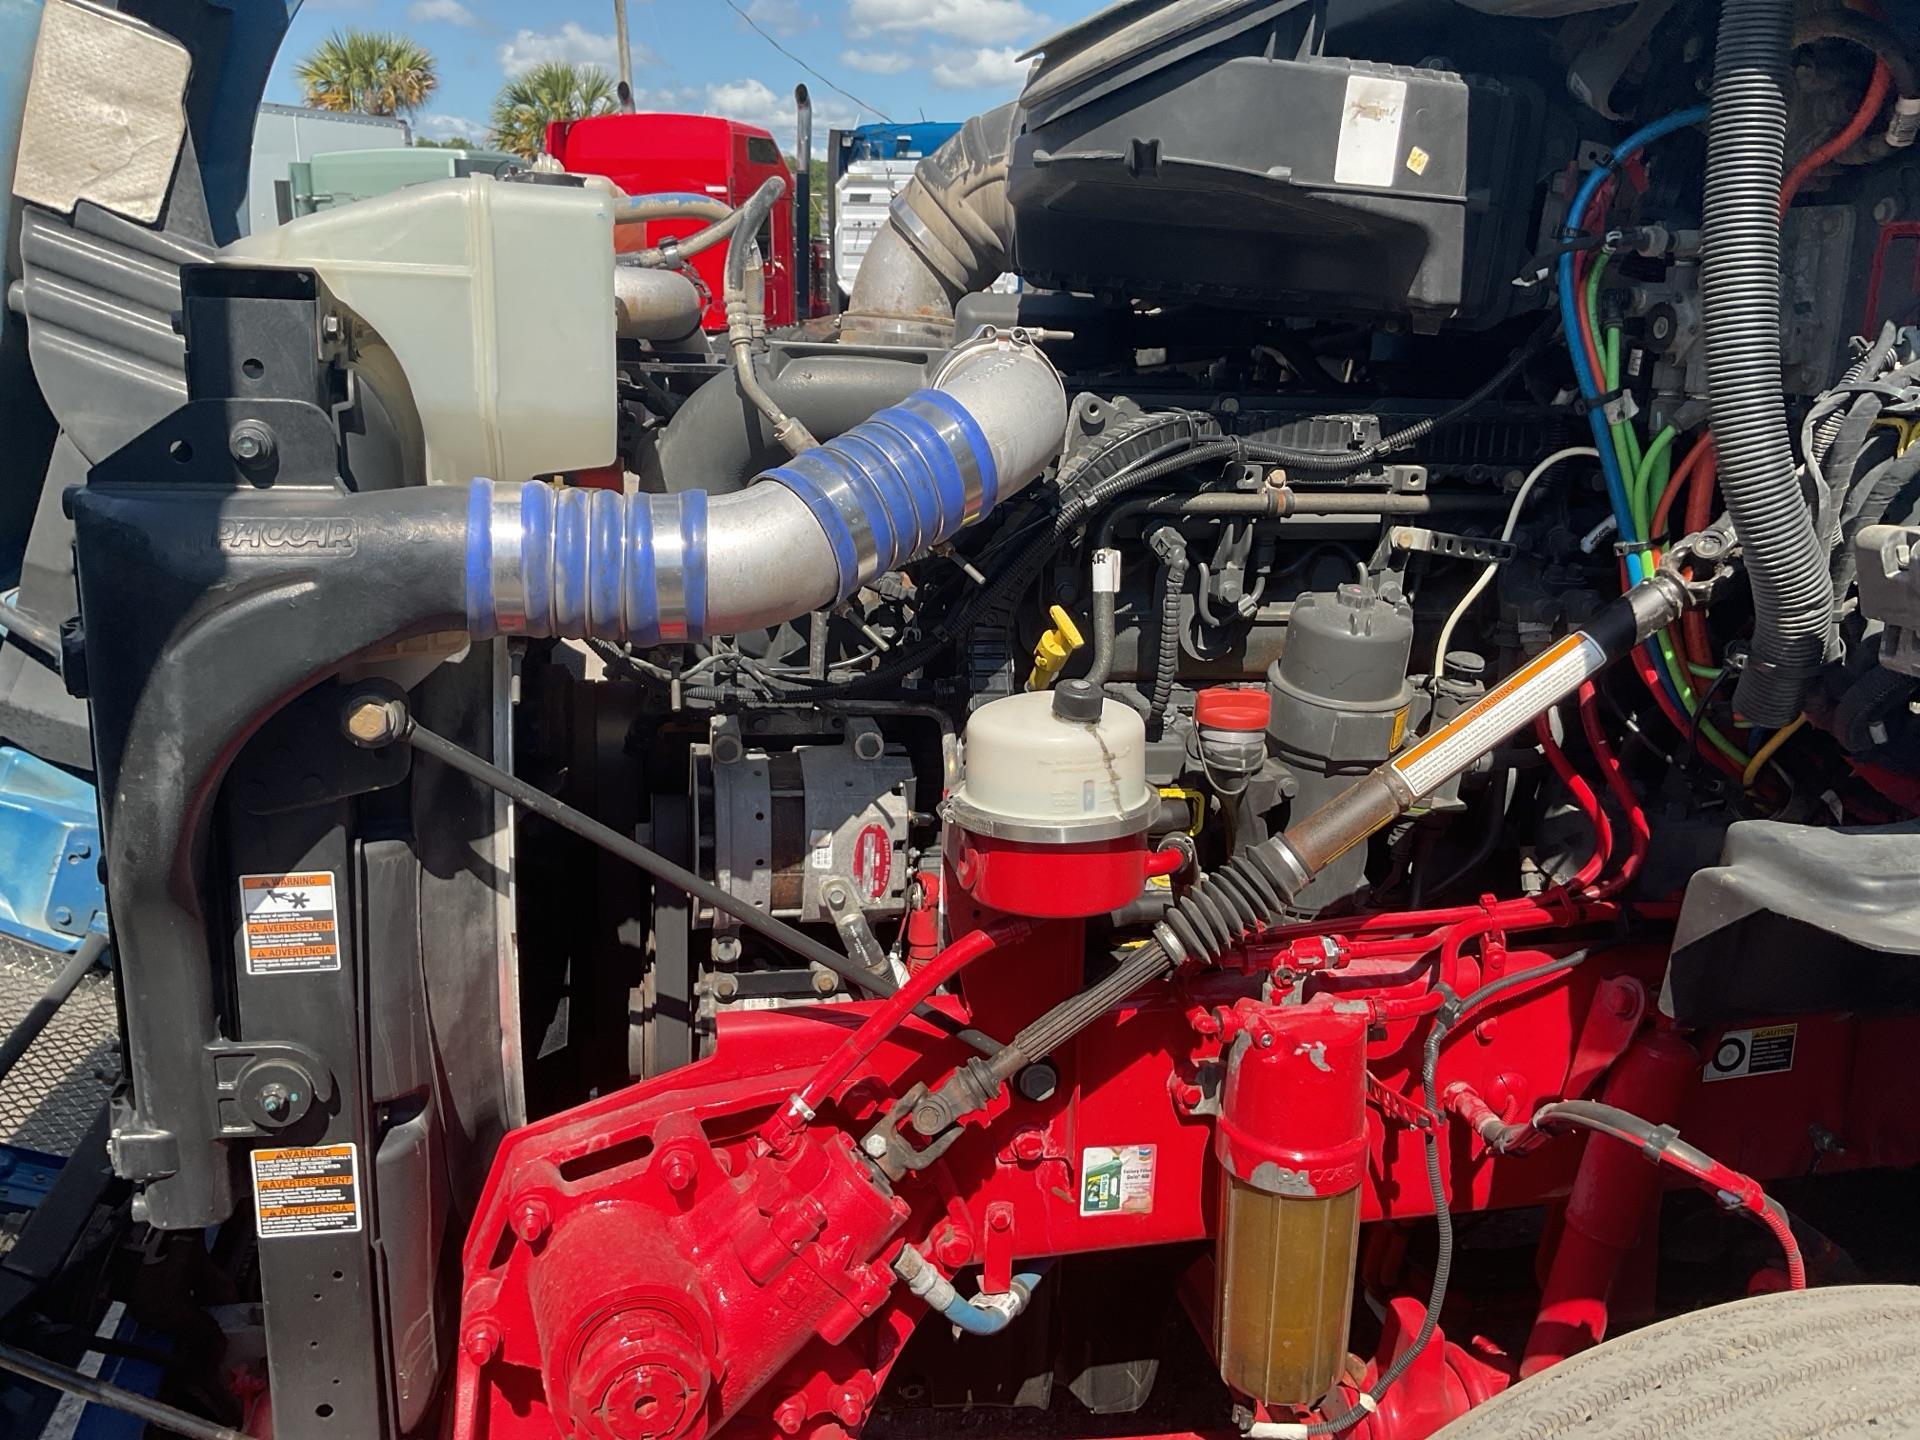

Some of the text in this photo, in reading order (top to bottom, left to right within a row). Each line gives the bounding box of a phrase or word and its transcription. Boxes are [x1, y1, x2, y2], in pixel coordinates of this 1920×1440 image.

[212, 519, 352, 548] PACCAR
[1473, 683, 1515, 716] WARNING
[271, 876, 316, 887] WARNING
[263, 921, 333, 932] AVERTISSEMENT
[269, 946, 331, 956] ADVERTENCIA
[1760, 1027, 1794, 1037] CAUTION
[282, 1149, 331, 1159] WARNING
[270, 1176, 350, 1188] AVERTISSEMENT
[280, 1205, 347, 1215] ADVERTENCIA
